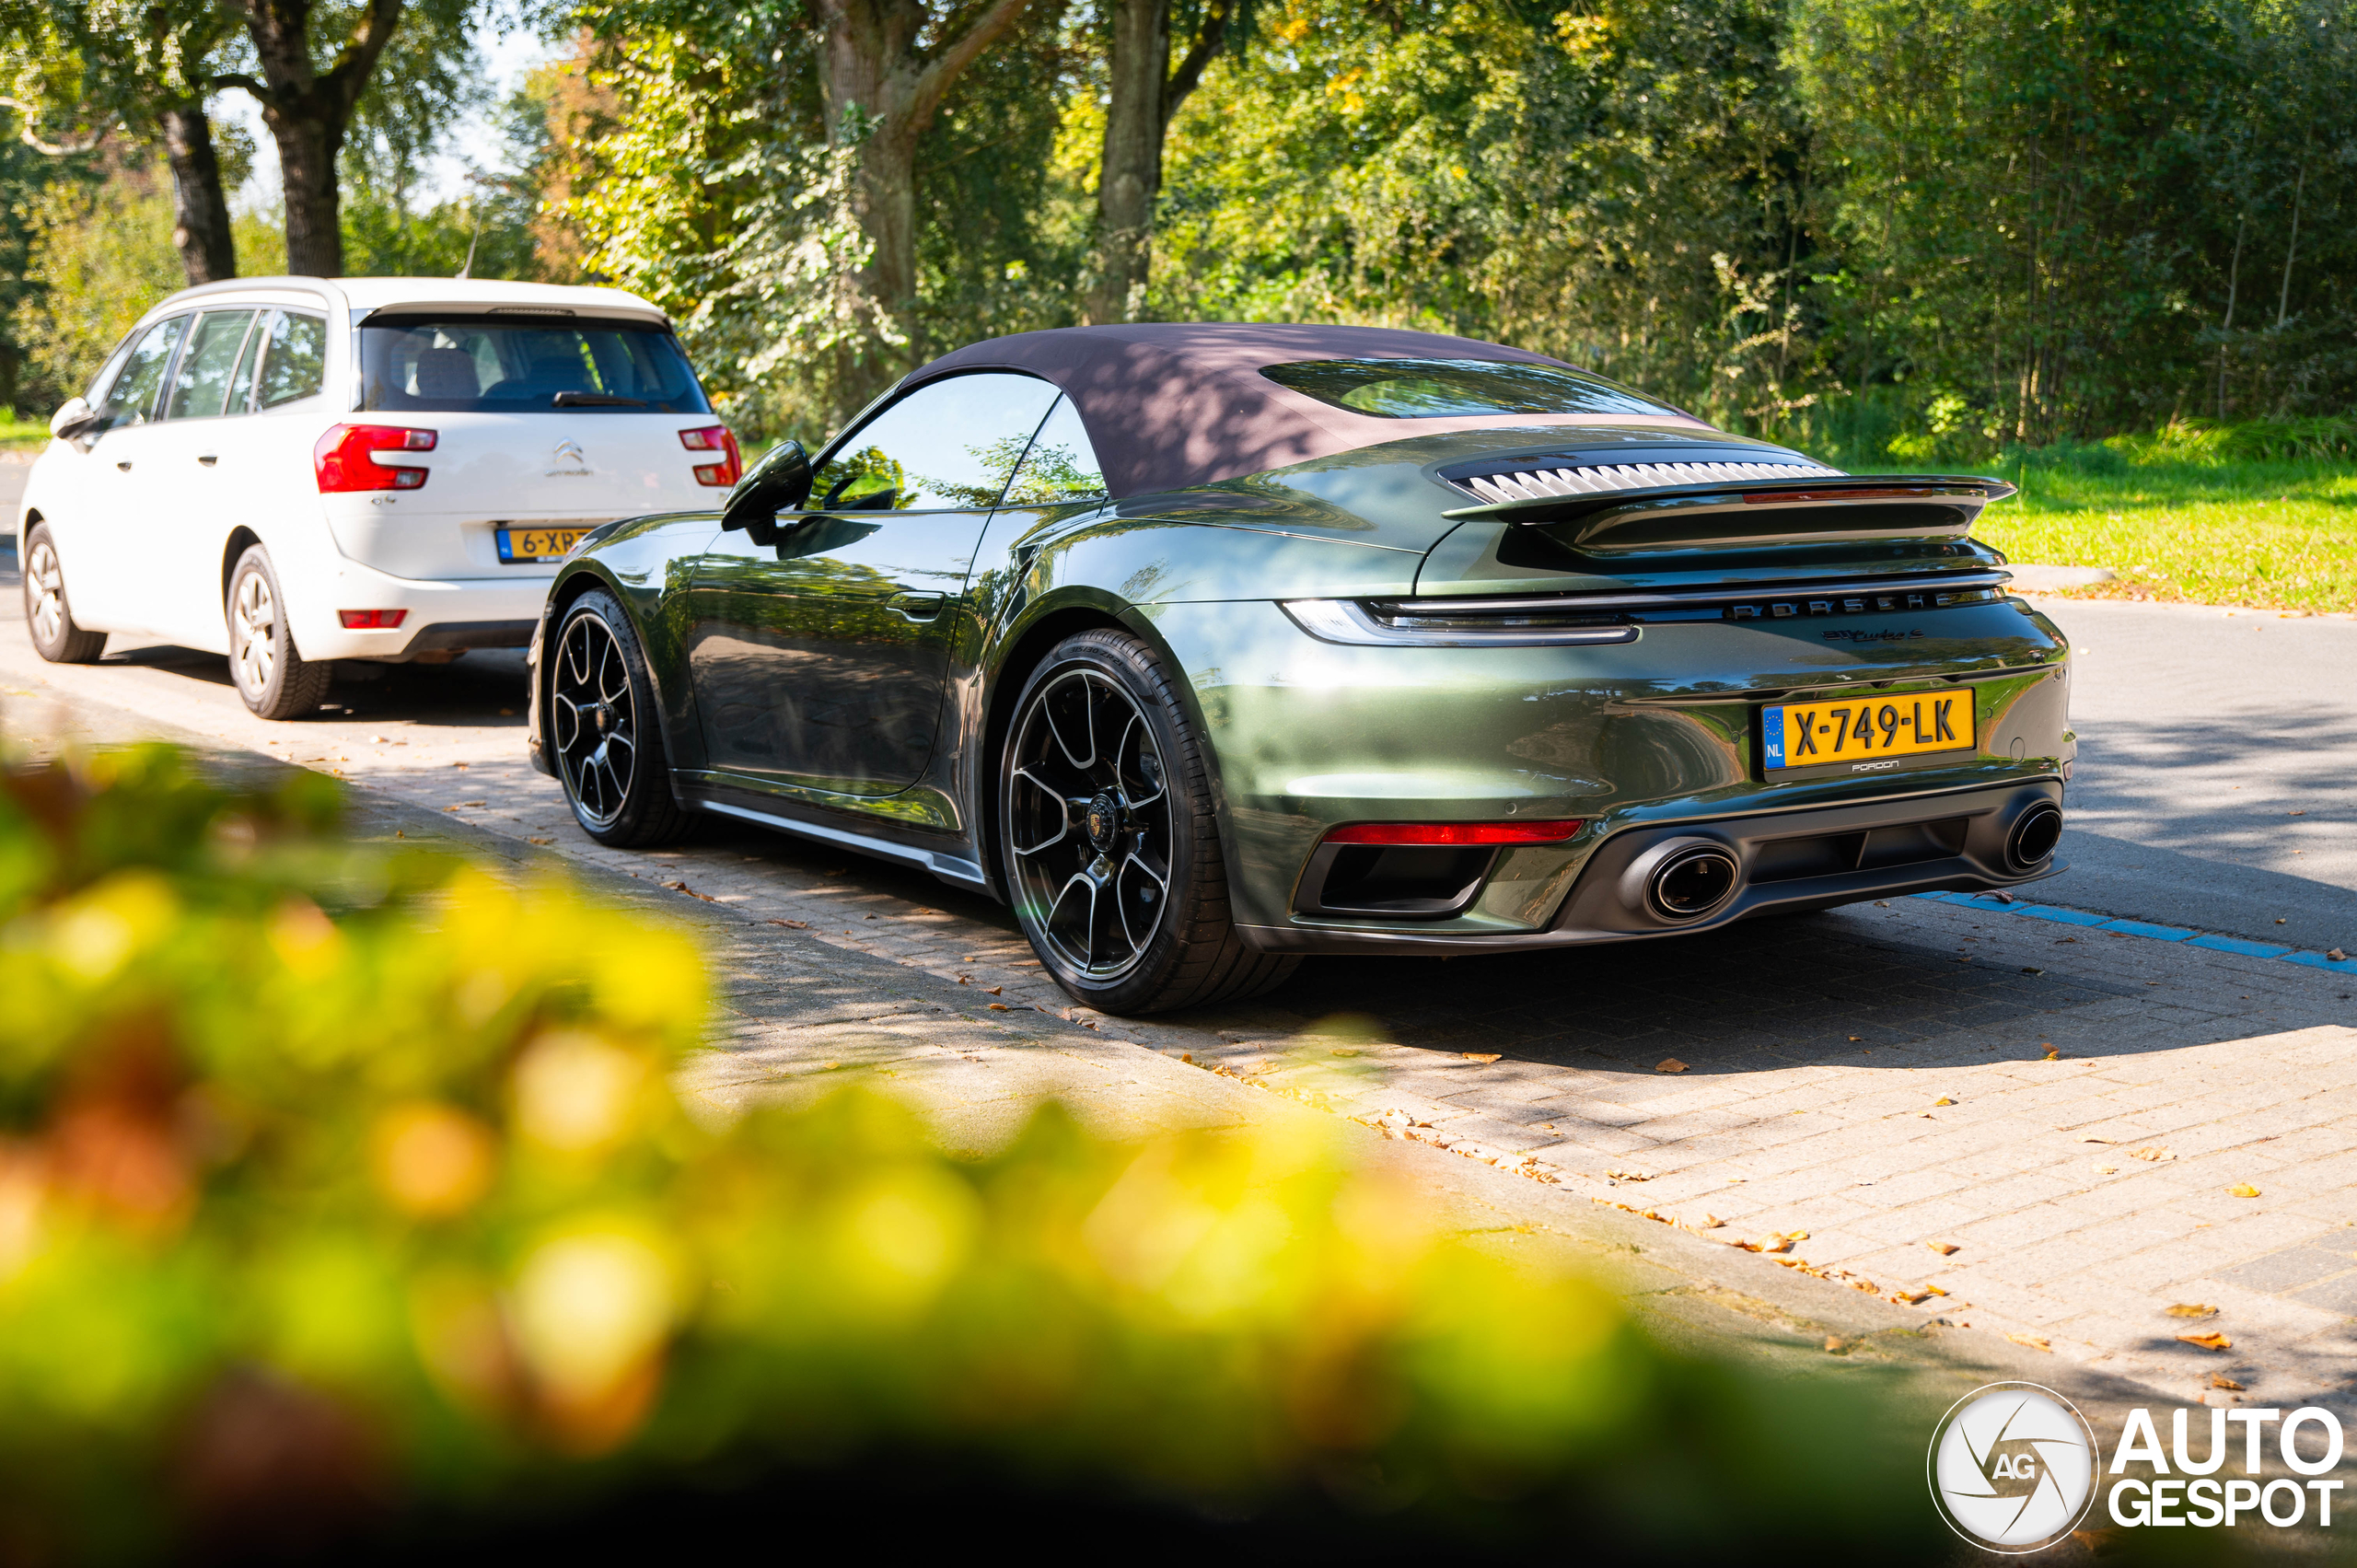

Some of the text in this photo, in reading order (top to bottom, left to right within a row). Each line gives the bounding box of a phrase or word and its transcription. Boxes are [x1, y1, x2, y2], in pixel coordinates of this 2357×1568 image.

[1733, 592, 1952, 621] PORSCHE
[1795, 699, 1956, 756] X-749-LK
[1767, 744, 1782, 758] NL
[1852, 760, 1899, 772] PORDON
